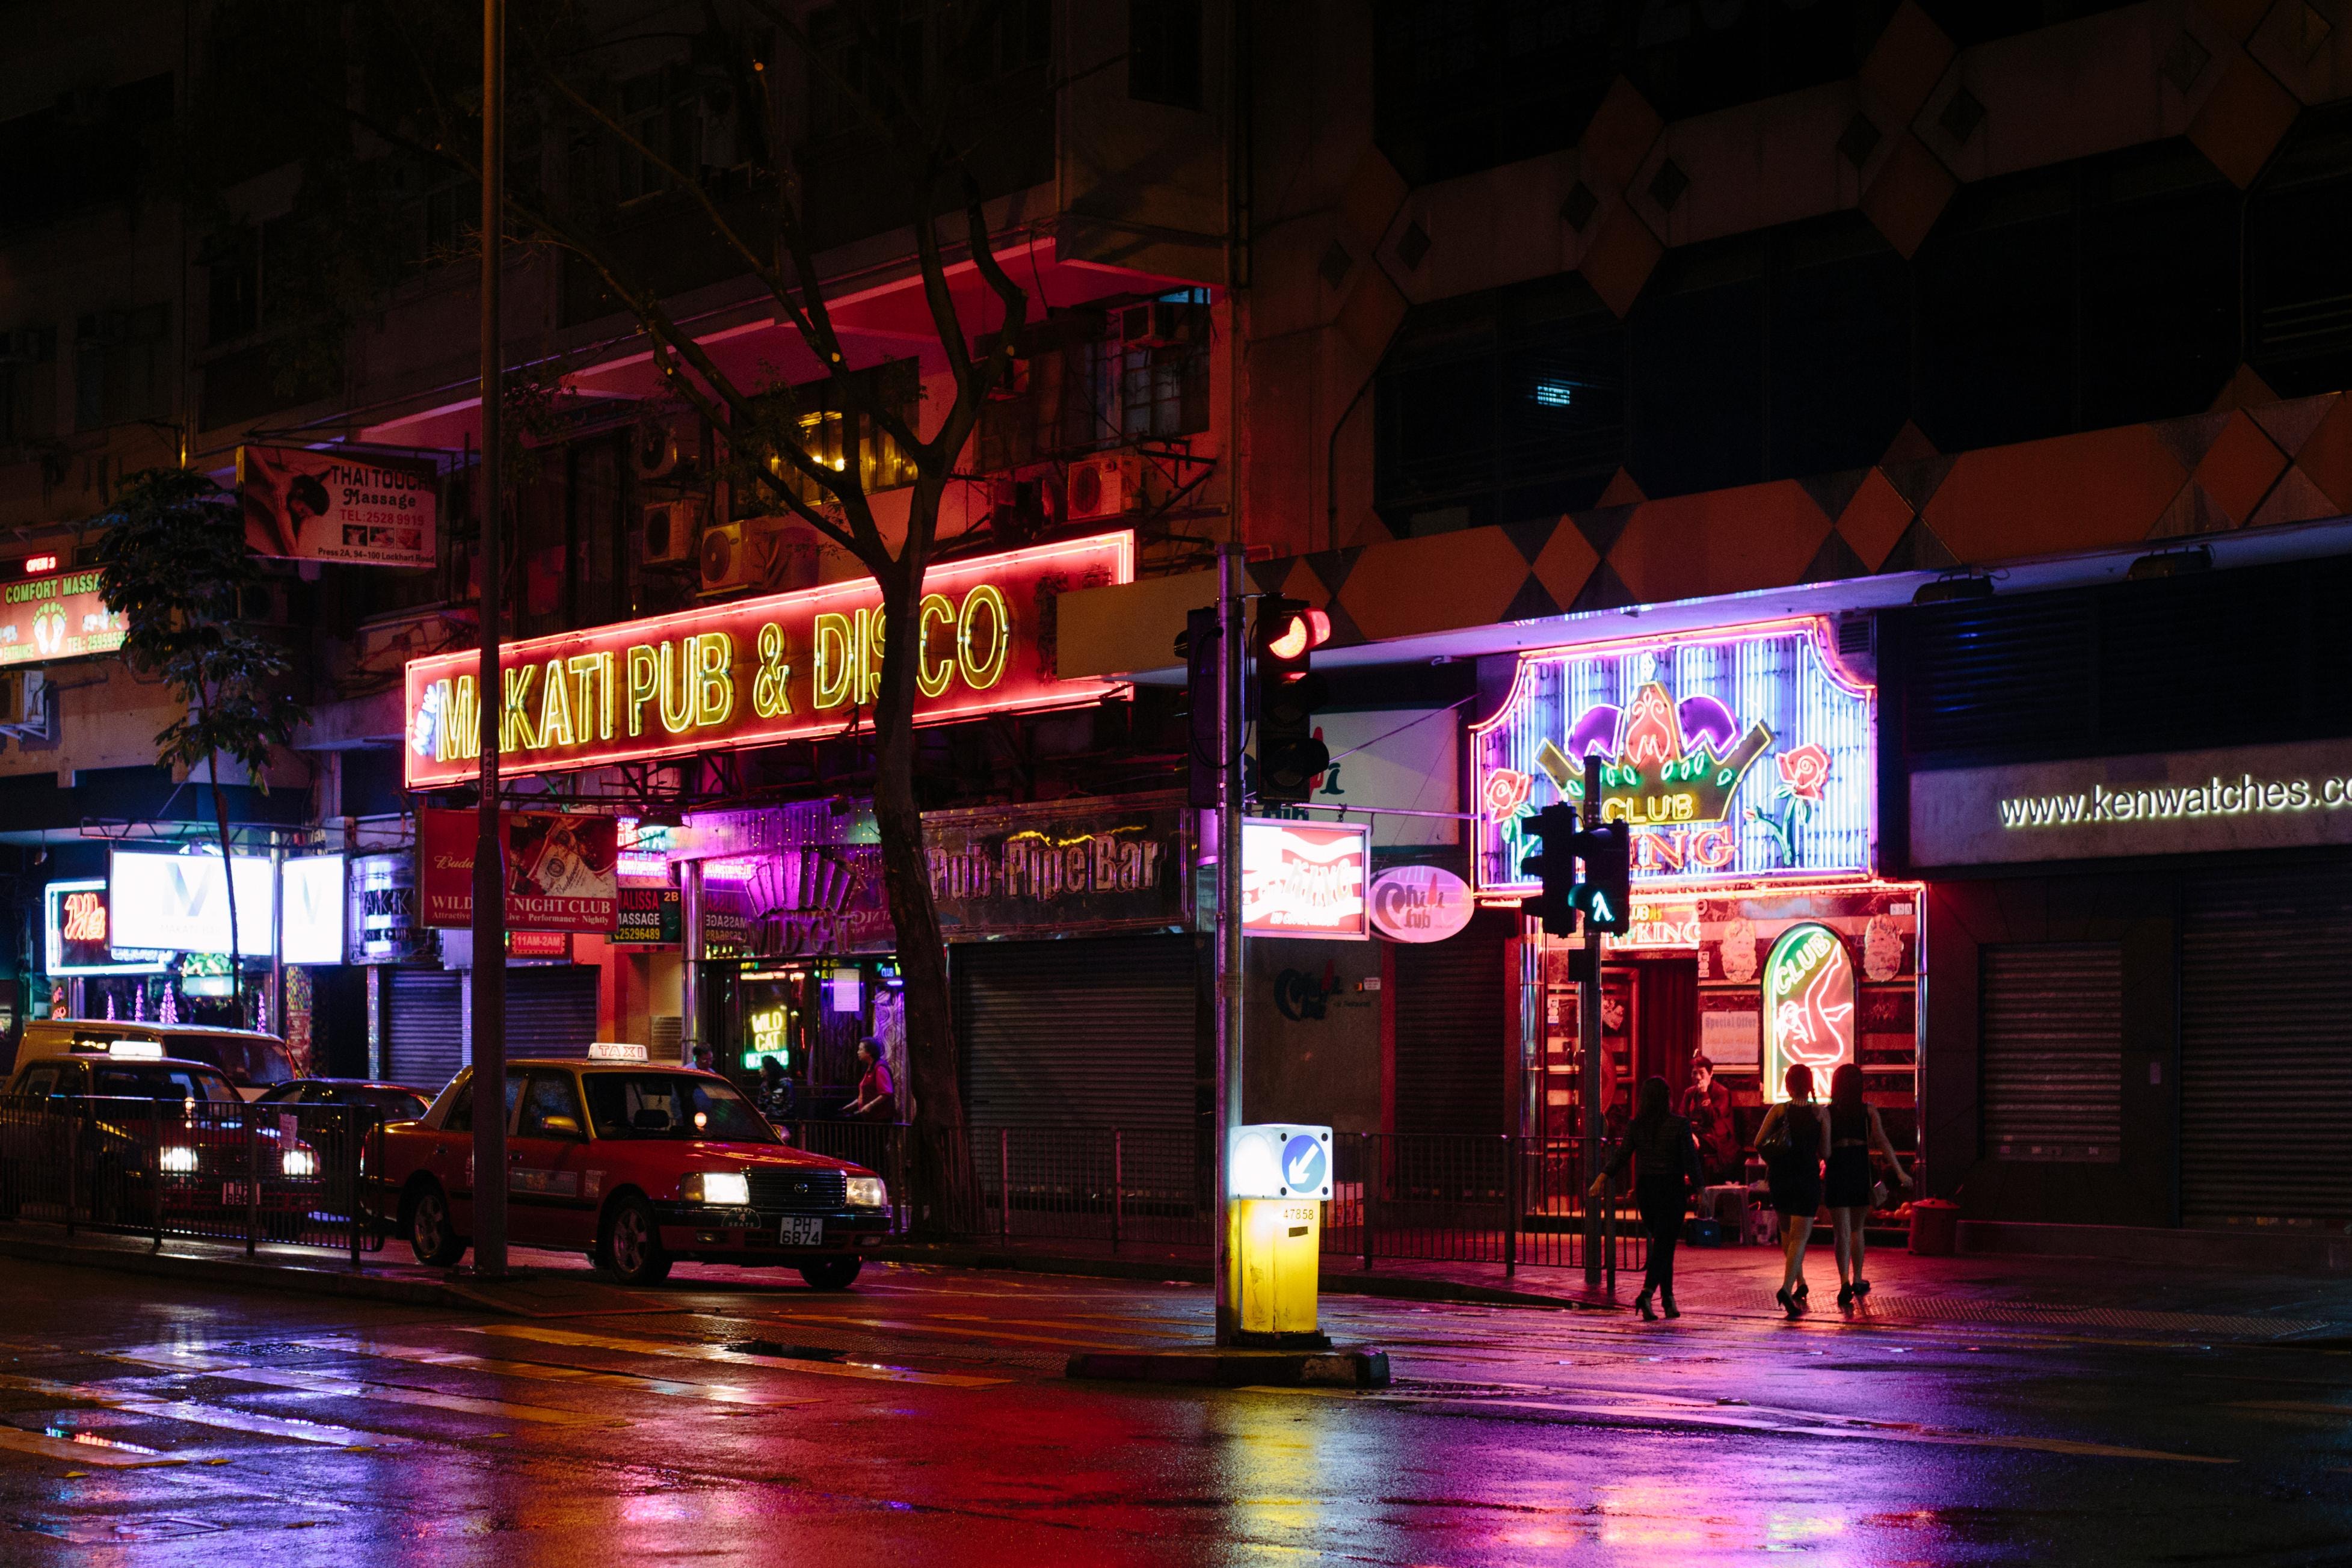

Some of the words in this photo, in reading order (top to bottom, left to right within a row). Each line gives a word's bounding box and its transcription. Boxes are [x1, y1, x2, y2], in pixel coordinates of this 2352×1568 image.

[331, 465, 368, 487] THAI
[372, 468, 428, 491] TOUCH
[343, 488, 416, 510] Massage
[318, 547, 338, 556] Press
[354, 550, 380, 559] 94-100
[381, 552, 414, 562] Lockhart
[415, 553, 434, 563] Road
[26, 558, 48, 572] OPEN
[5, 579, 58, 604] COMFORT
[63, 573, 101, 596] MASSA
[627, 632, 733, 737] PUB
[753, 622, 792, 719] &
[1601, 793, 1693, 823] CLUB
[1629, 825, 1736, 870] ING
[432, 896, 472, 909] WILD
[514, 898, 565, 912] NIGHT
[568, 900, 611, 914] CLUB
[664, 892, 679, 902] 2B
[432, 911, 471, 920] Attractive
[529, 914, 576, 923] Performance
[582, 917, 609, 925] Nightly
[517, 935, 560, 947] 11AM-2AM
[620, 928, 660, 939] 25296489
[1776, 932, 1831, 995] CLUB
[752, 1011, 783, 1033] WILD
[755, 1030, 781, 1052] CAT
[599, 1045, 643, 1057] TAXI
[739, 1213, 746, 1222] 4
[1282, 1209, 1314, 1220] 47858
[793, 1218, 811, 1232] PH
[782, 1231, 819, 1244] 6874
